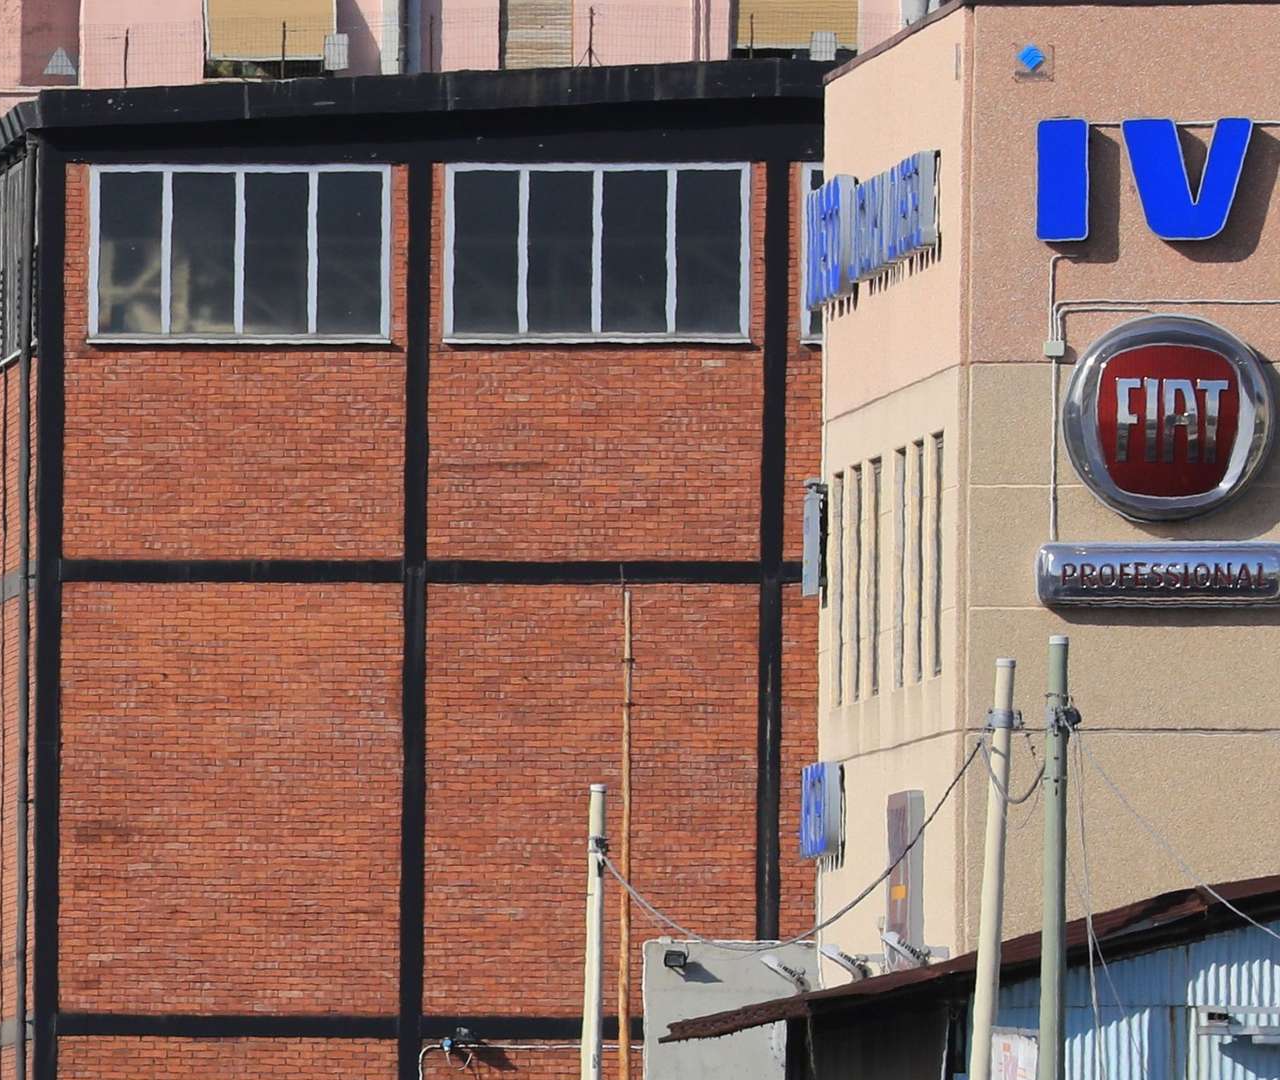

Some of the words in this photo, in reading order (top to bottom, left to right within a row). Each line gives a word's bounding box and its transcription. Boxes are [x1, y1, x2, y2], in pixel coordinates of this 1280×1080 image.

[1035, 117, 1253, 241] IV
[1116, 377, 1229, 463] FIAT
[1060, 562, 1270, 589] PROFESSIONAL
